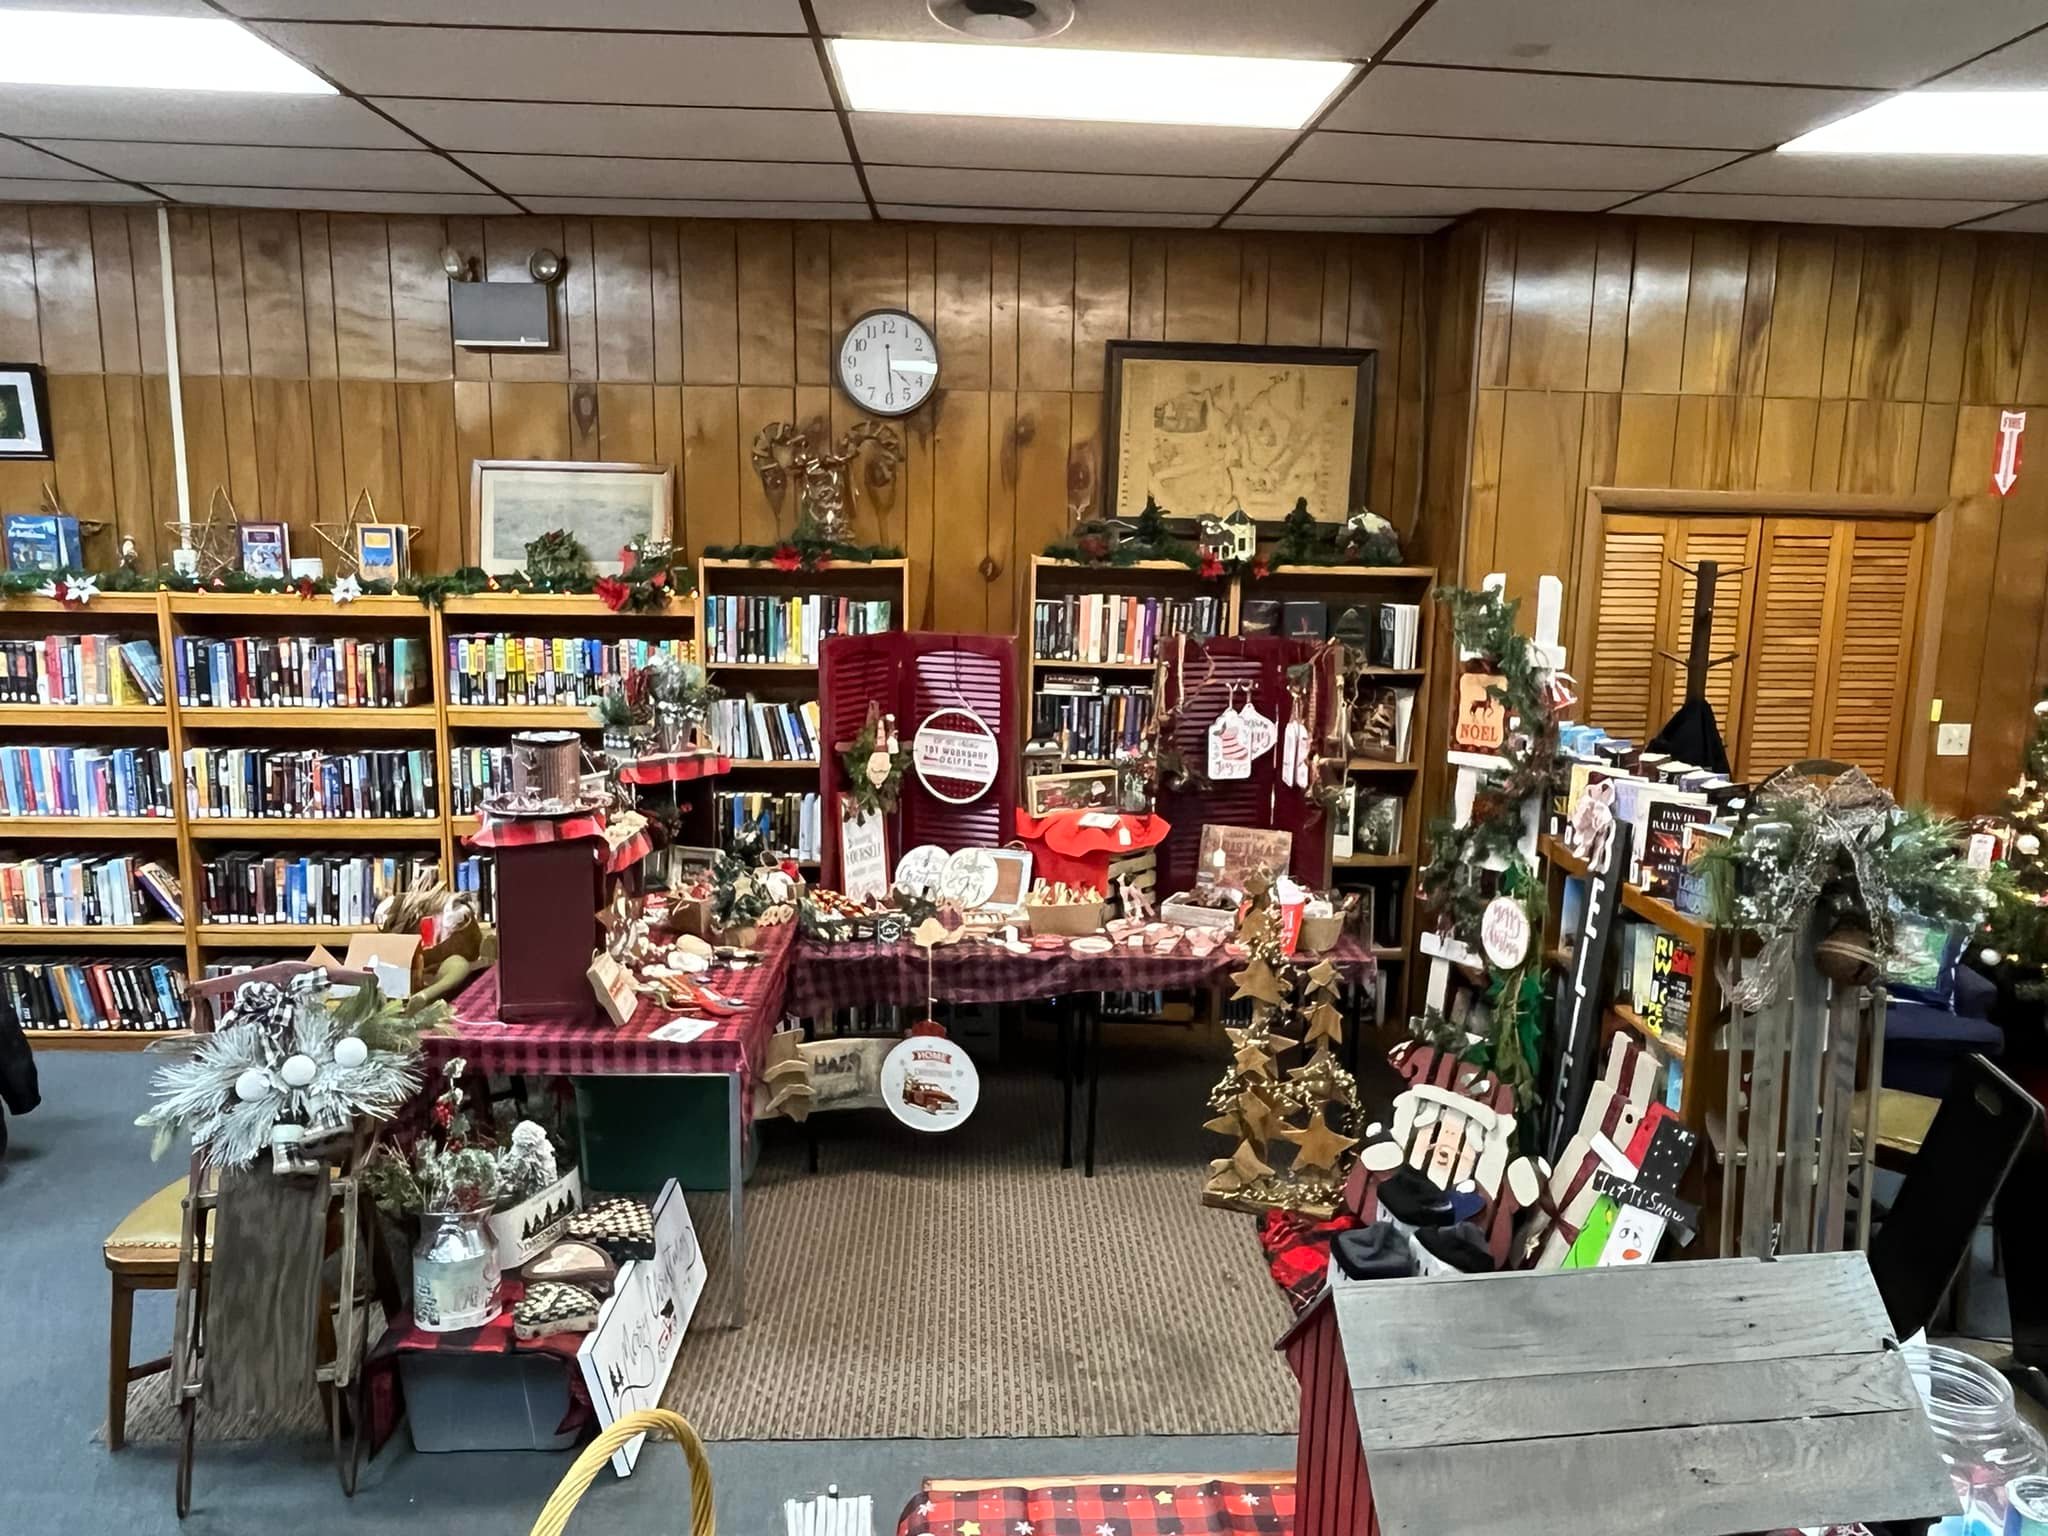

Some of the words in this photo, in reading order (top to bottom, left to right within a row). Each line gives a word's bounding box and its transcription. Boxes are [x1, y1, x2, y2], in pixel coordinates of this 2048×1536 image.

[867, 325, 877, 339] 11
[882, 320, 895, 334] 12
[904, 324, 909, 339] 1
[855, 338, 867, 352] 10
[914, 337, 923, 352] 2
[847, 355, 857, 369] 9
[854, 374, 863, 387] 8
[915, 375, 923, 388] 4
[867, 386, 876, 400] 7
[885, 391, 894, 405] 6
[903, 387, 912, 401] 5
[1460, 723, 1499, 741] NOEL
[1662, 810, 1696, 823] DAVID
